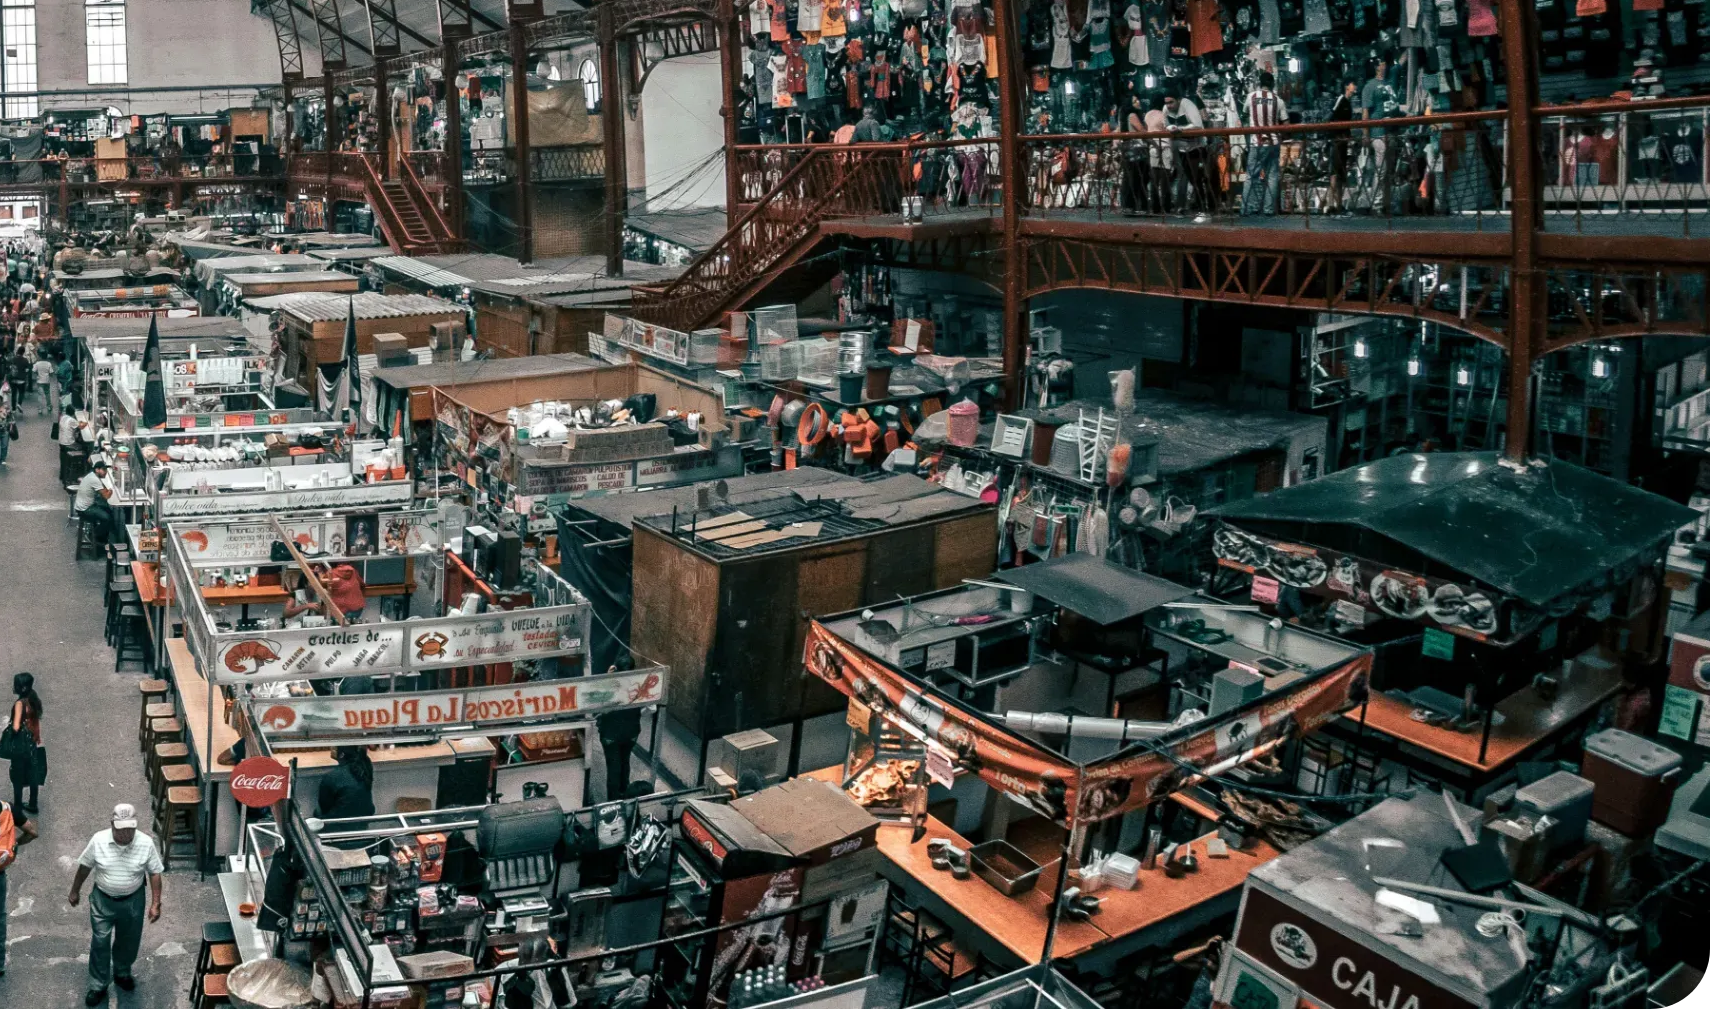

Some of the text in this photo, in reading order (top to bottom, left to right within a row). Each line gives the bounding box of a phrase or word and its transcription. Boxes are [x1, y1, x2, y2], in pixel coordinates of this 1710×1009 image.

[308, 631, 359, 646] Cocteles
[325, 650, 342, 668] PULPO
[352, 649, 369, 667] JAIBA
[232, 773, 286, 790] Coca-Cola
[1331, 956, 1420, 1009] CAJA
